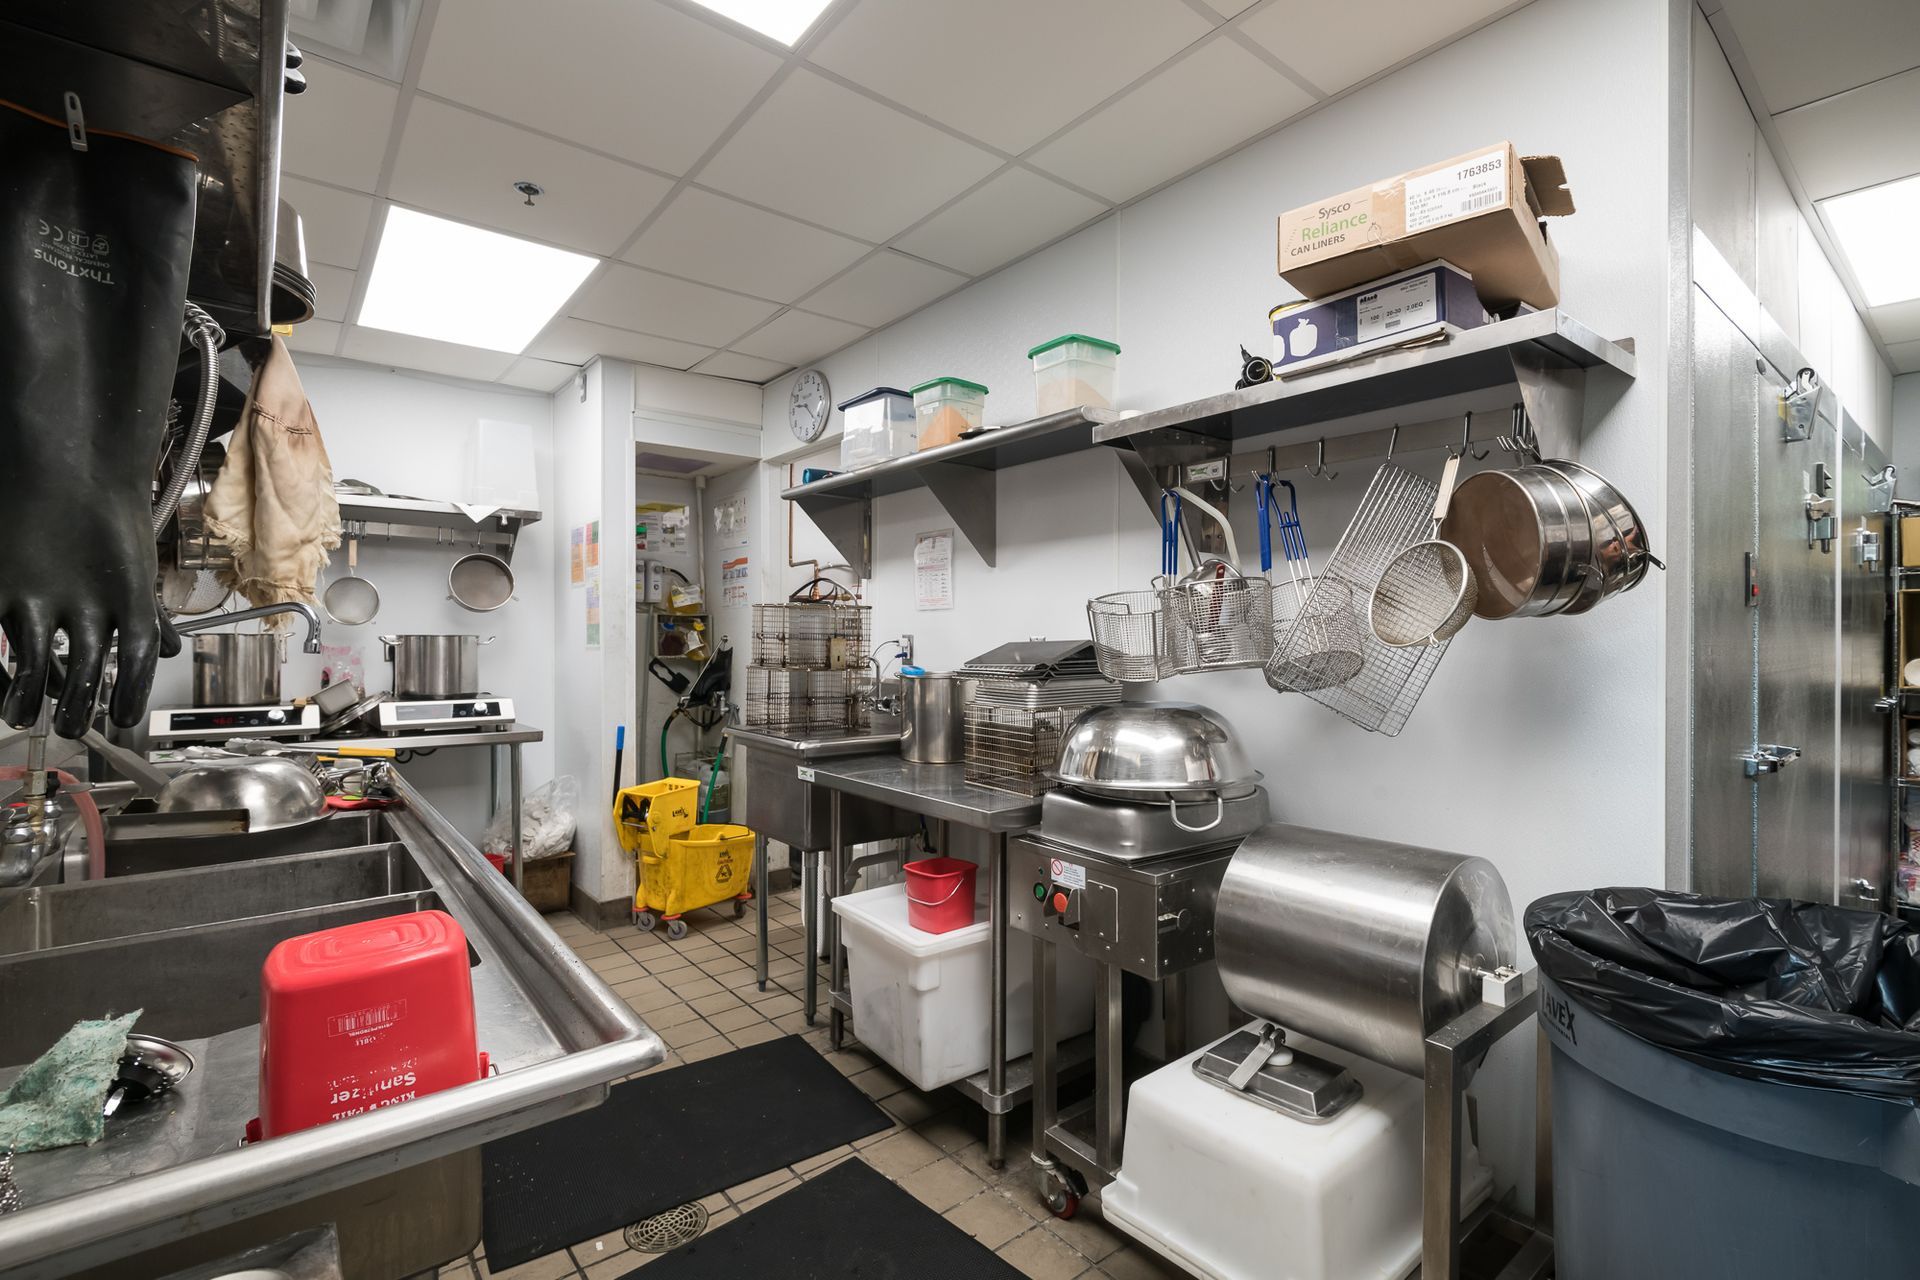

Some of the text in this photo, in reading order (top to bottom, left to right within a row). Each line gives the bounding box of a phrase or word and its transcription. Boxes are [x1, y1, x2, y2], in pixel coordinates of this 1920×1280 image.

[1457, 159, 1502, 181] 1763853
[1318, 202, 1351, 220] Sysco
[1301, 213, 1368, 242] Reliance
[1290, 234, 1346, 257] CAN LINERS
[33, 248, 115, 285] ThxToms
